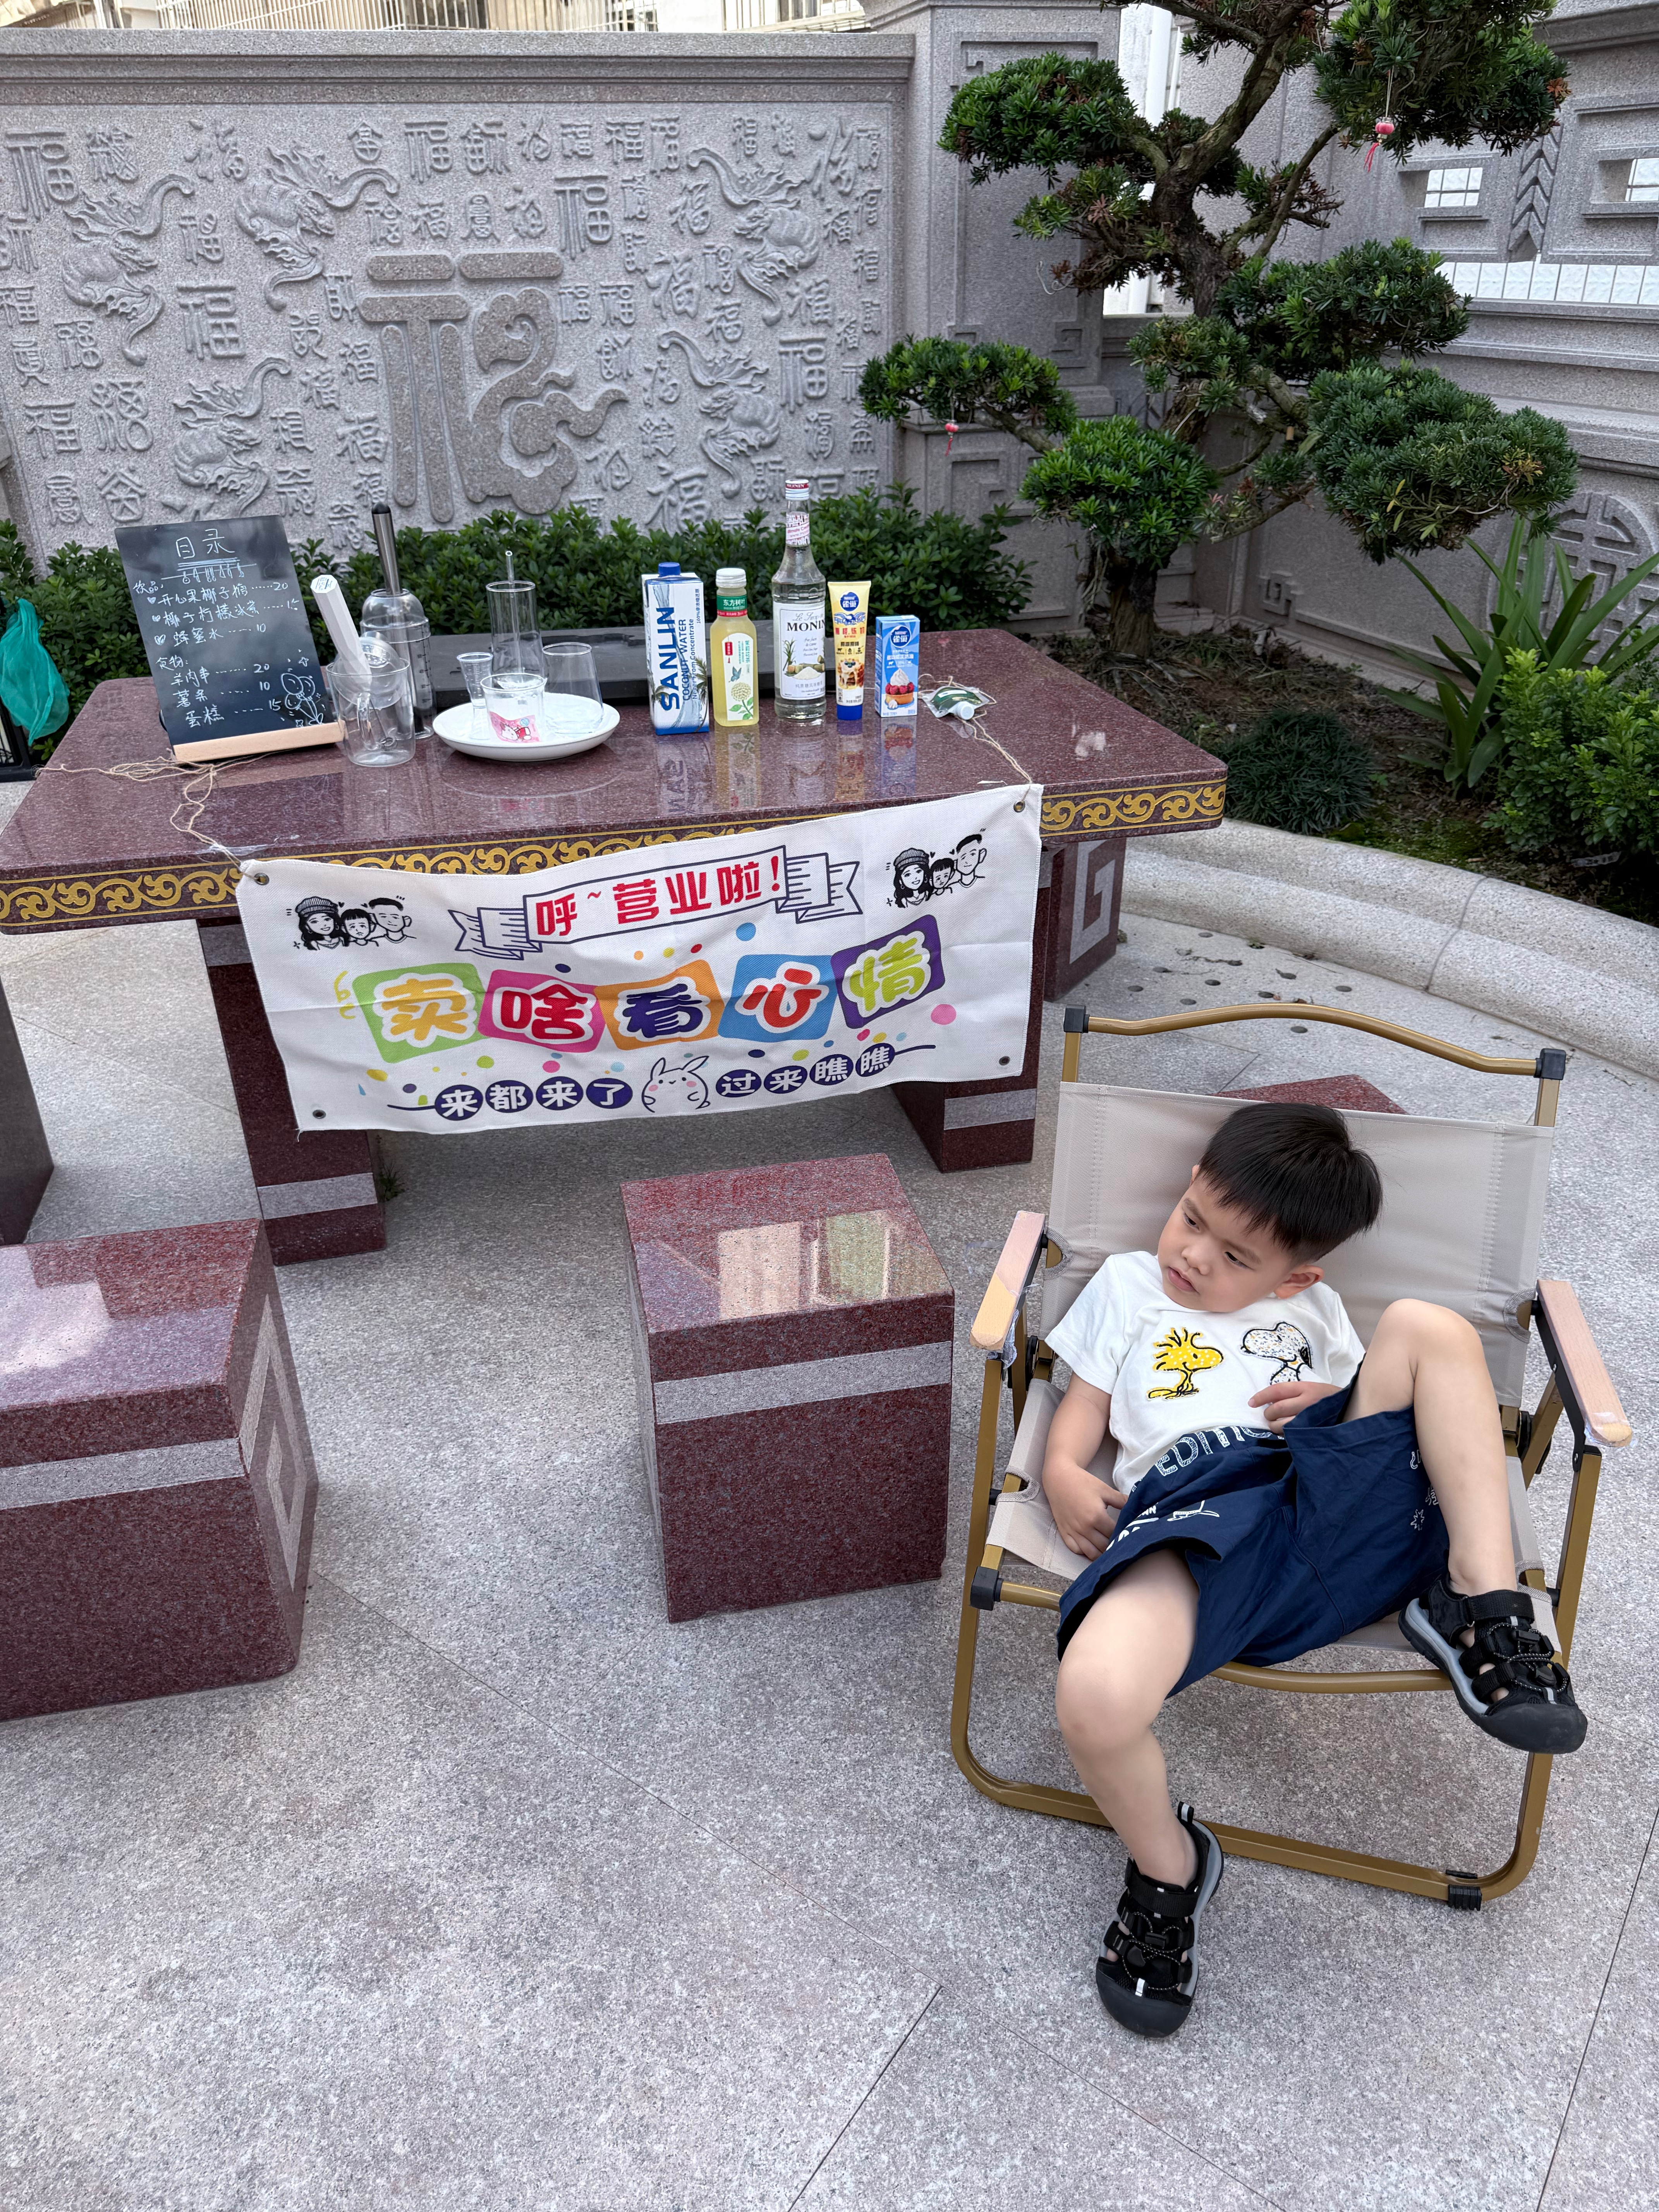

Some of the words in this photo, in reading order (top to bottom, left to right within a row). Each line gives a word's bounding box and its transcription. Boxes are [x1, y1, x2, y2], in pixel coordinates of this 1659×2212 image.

[554, 175, 614, 261] 福
[176, 282, 246, 361] 福
[778, 338, 829, 414] 福
[23, 400, 81, 460] 福
[336, 414, 388, 464] 福
[176, 529, 235, 559] 目录
[273, 582, 288, 591] 20
[723, 598, 745, 606] 东方树叶
[173, 627, 224, 647] 蜂蜜水
[257, 623, 266, 632] 10
[678, 619, 688, 654] WATER
[787, 619, 825, 632] MONIN
[171, 666, 210, 688] 羊肉串
[254, 663, 270, 673] 20
[656, 607, 680, 711] SANLIN
[173, 688, 208, 708] 薯条
[259, 681, 270, 691] 10
[680, 659, 690, 701] COCONUT
[185, 704, 225, 728] 蛋糕
[269, 698, 282, 711] 15
[382, 936, 930, 1042] 卖啥看心情
[440, 1080, 630, 1118] 来都来了
[723, 1047, 891, 1097] 过来瞧瞧
